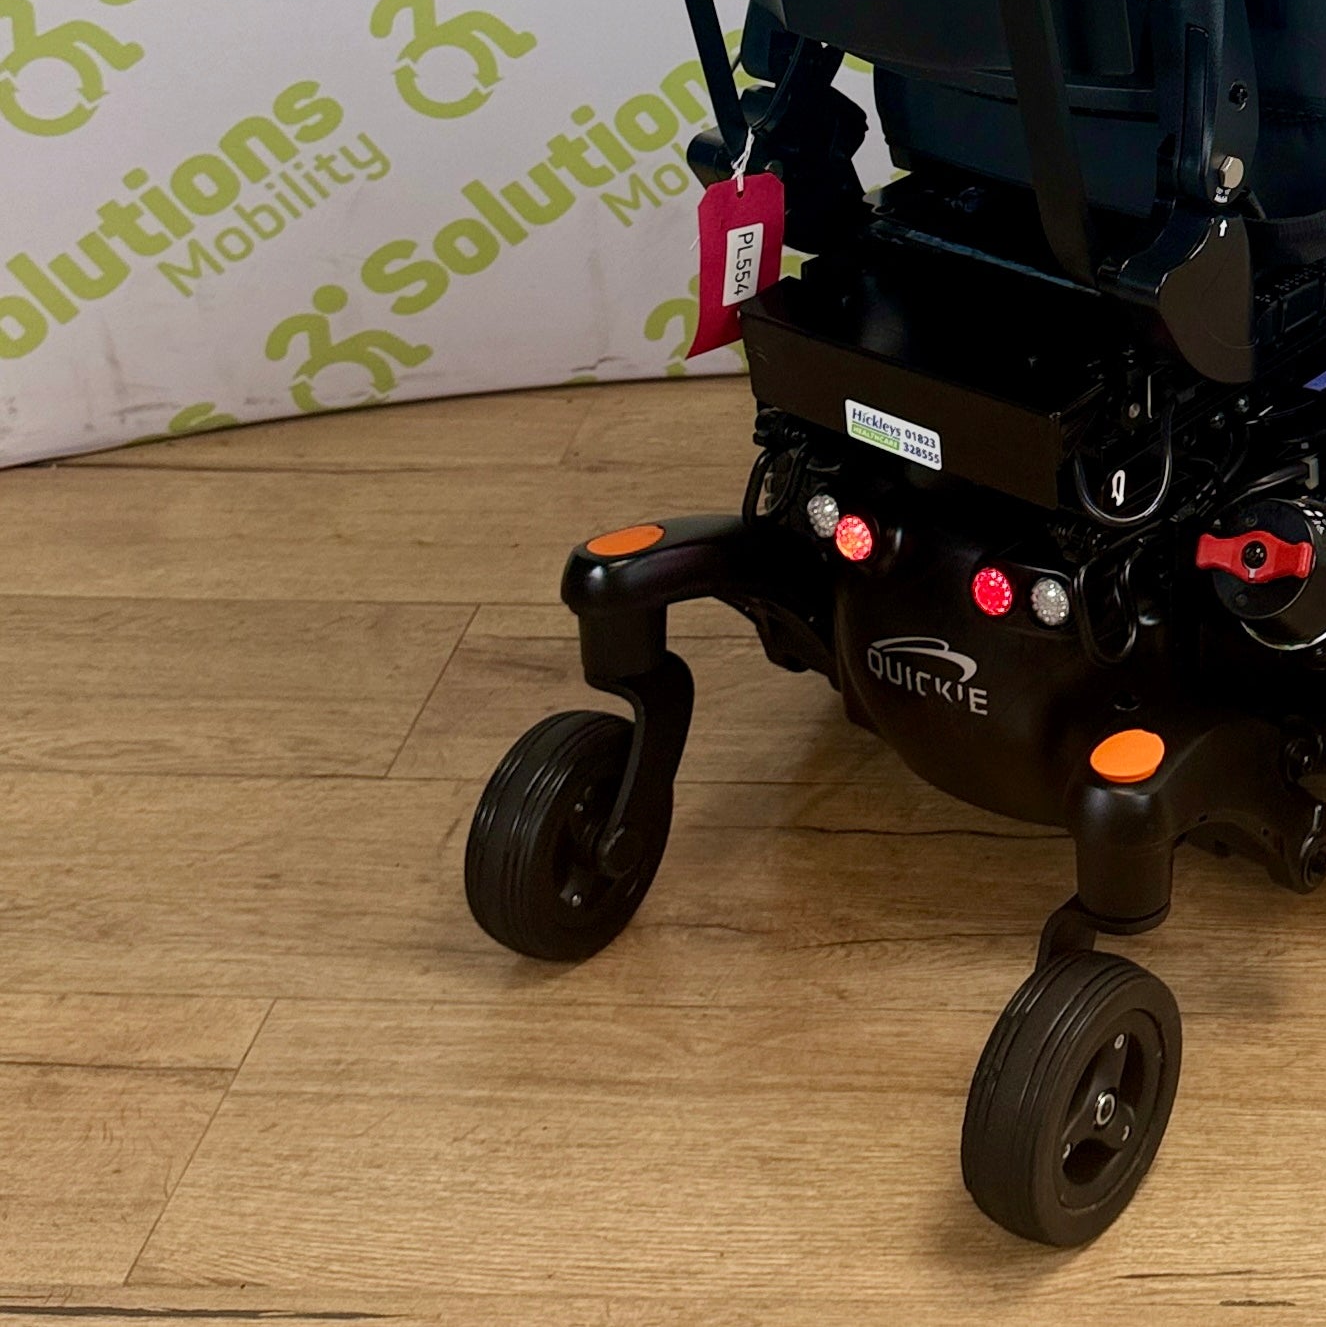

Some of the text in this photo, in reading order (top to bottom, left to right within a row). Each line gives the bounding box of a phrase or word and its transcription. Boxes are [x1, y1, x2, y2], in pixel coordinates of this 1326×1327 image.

[156, 133, 392, 298] Mobility
[733, 231, 754, 296] PL554
[852, 408, 936, 449] Hickleys 01823
[903, 442, 940, 464] 328555
[867, 648, 988, 716] QUICKIE
